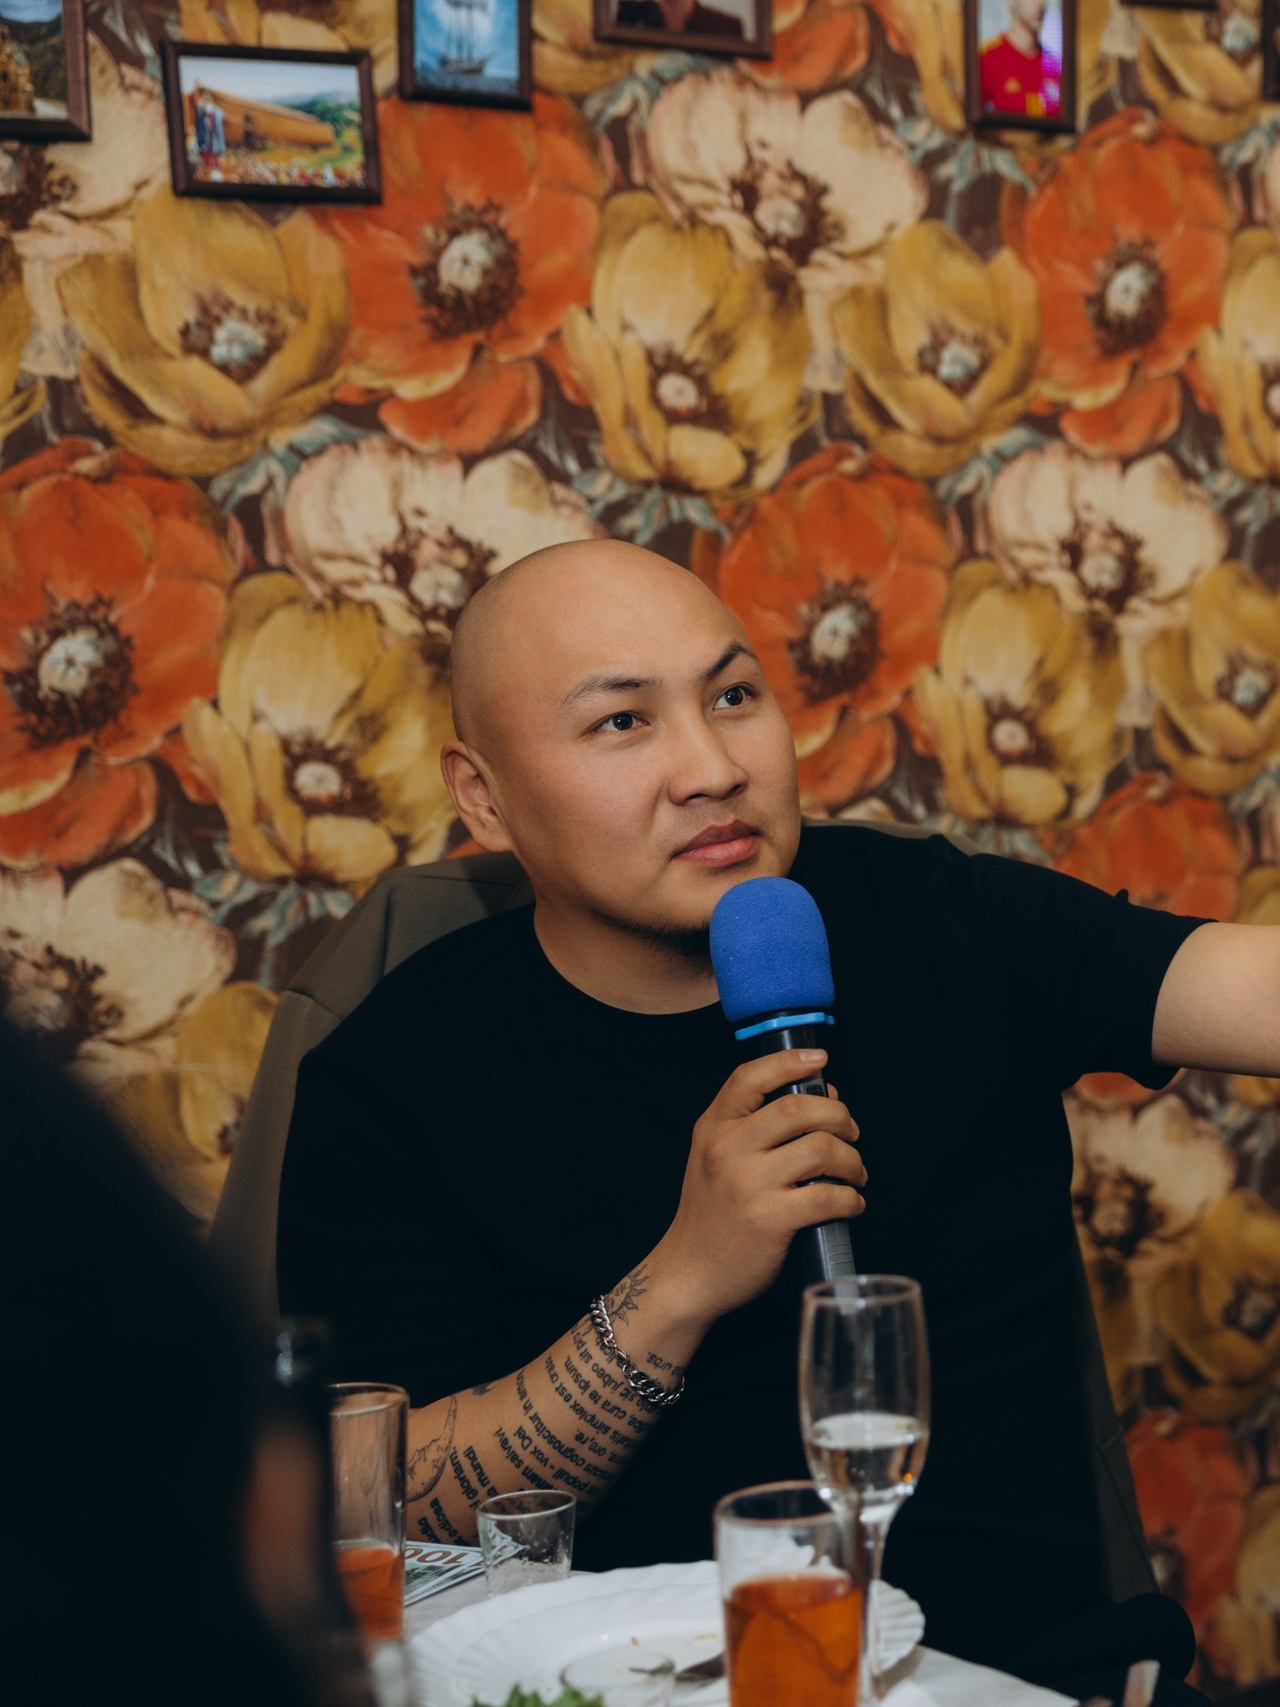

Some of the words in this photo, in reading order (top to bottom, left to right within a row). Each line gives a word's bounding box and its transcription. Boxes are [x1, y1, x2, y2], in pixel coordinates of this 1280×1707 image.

[572, 1331, 585, 1351] pro
[578, 1347, 593, 1364] sit
[590, 1362, 624, 1393] jubeo
[554, 1382, 572, 1403] est
[587, 1389, 602, 1404] te
[617, 1386, 636, 1401] sic
[520, 1398, 534, 1416] in
[568, 1399, 610, 1436] simplex
[600, 1399, 626, 1420] cura
[512, 1425, 533, 1451] Dei
[528, 1411, 585, 1467] cognoscitur
[462, 1444, 491, 1487] mundi
[528, 1445, 548, 1468] vox
[449, 1446, 478, 1500] gloriam.
[430, 1496, 457, 1537] odiosa
